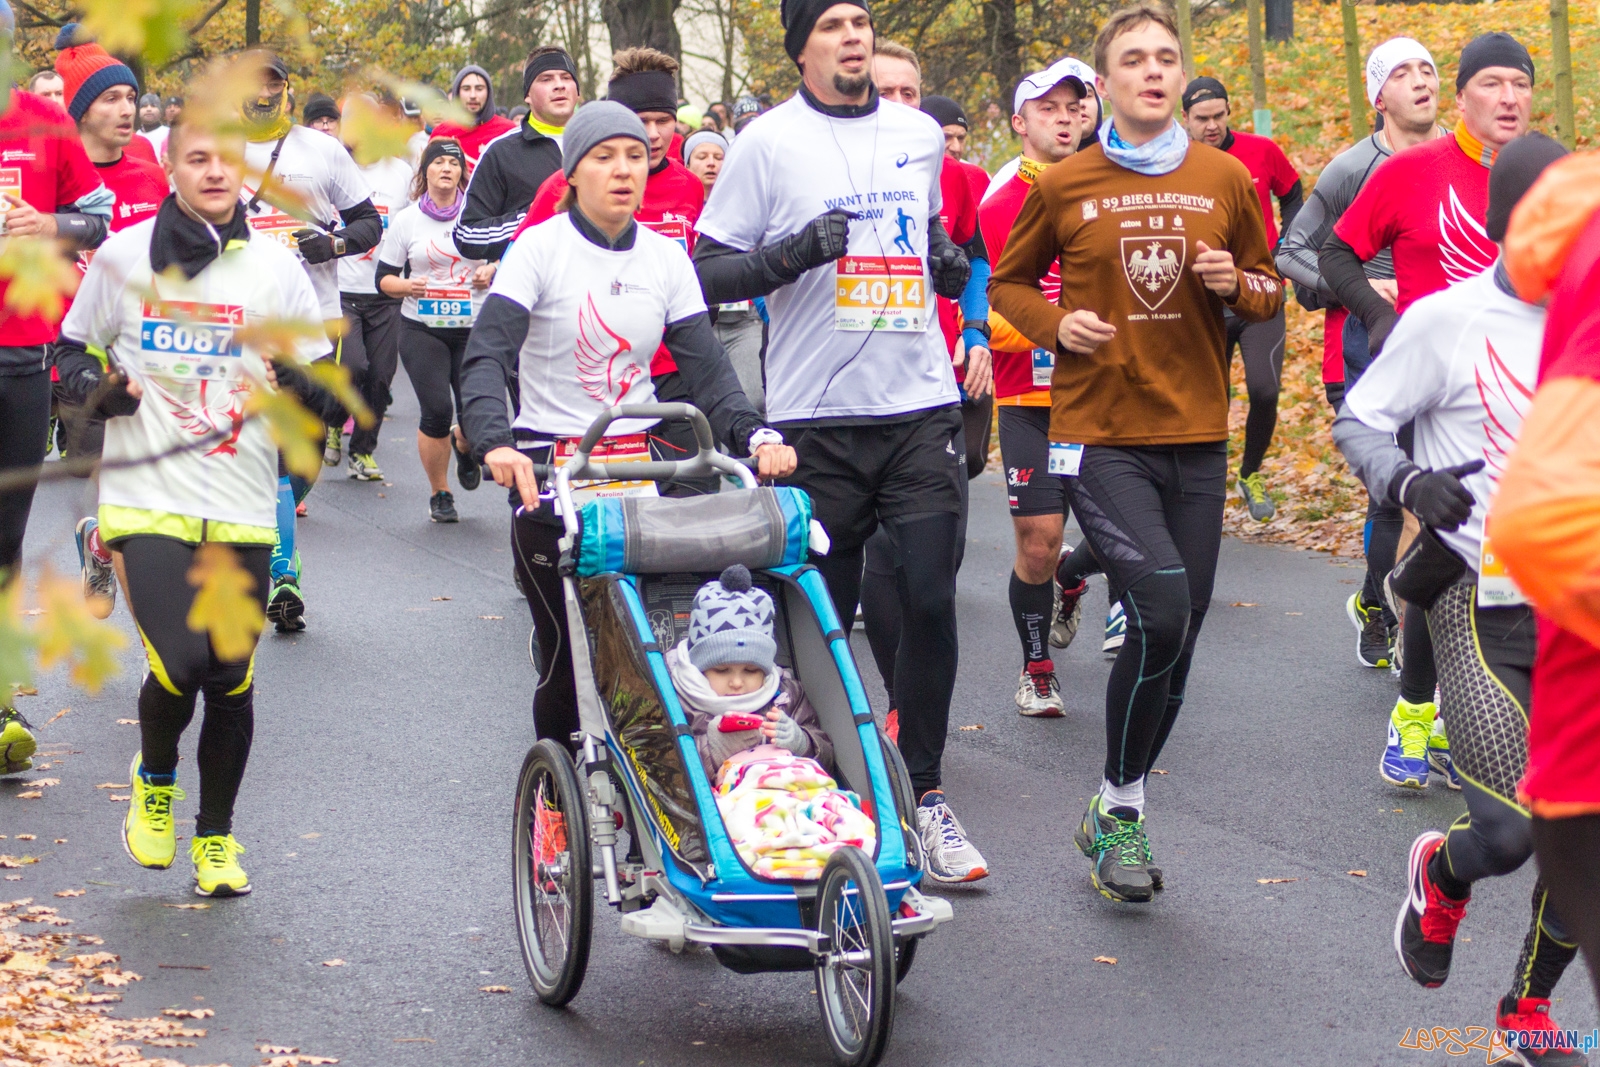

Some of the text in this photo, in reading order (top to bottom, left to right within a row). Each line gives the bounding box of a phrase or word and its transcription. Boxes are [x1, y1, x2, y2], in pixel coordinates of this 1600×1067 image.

[824, 191, 919, 210] WANT IT MORE,
[1102, 197, 1119, 209] 39
[1122, 193, 1154, 206] BIEG
[1156, 192, 1215, 210] LECHITÓW
[839, 281, 921, 305] D 4014
[430, 301, 461, 315] 199
[142, 324, 234, 354] E 6087
[1484, 554, 1495, 565] D
[1021, 612, 1044, 659] Kalenji
